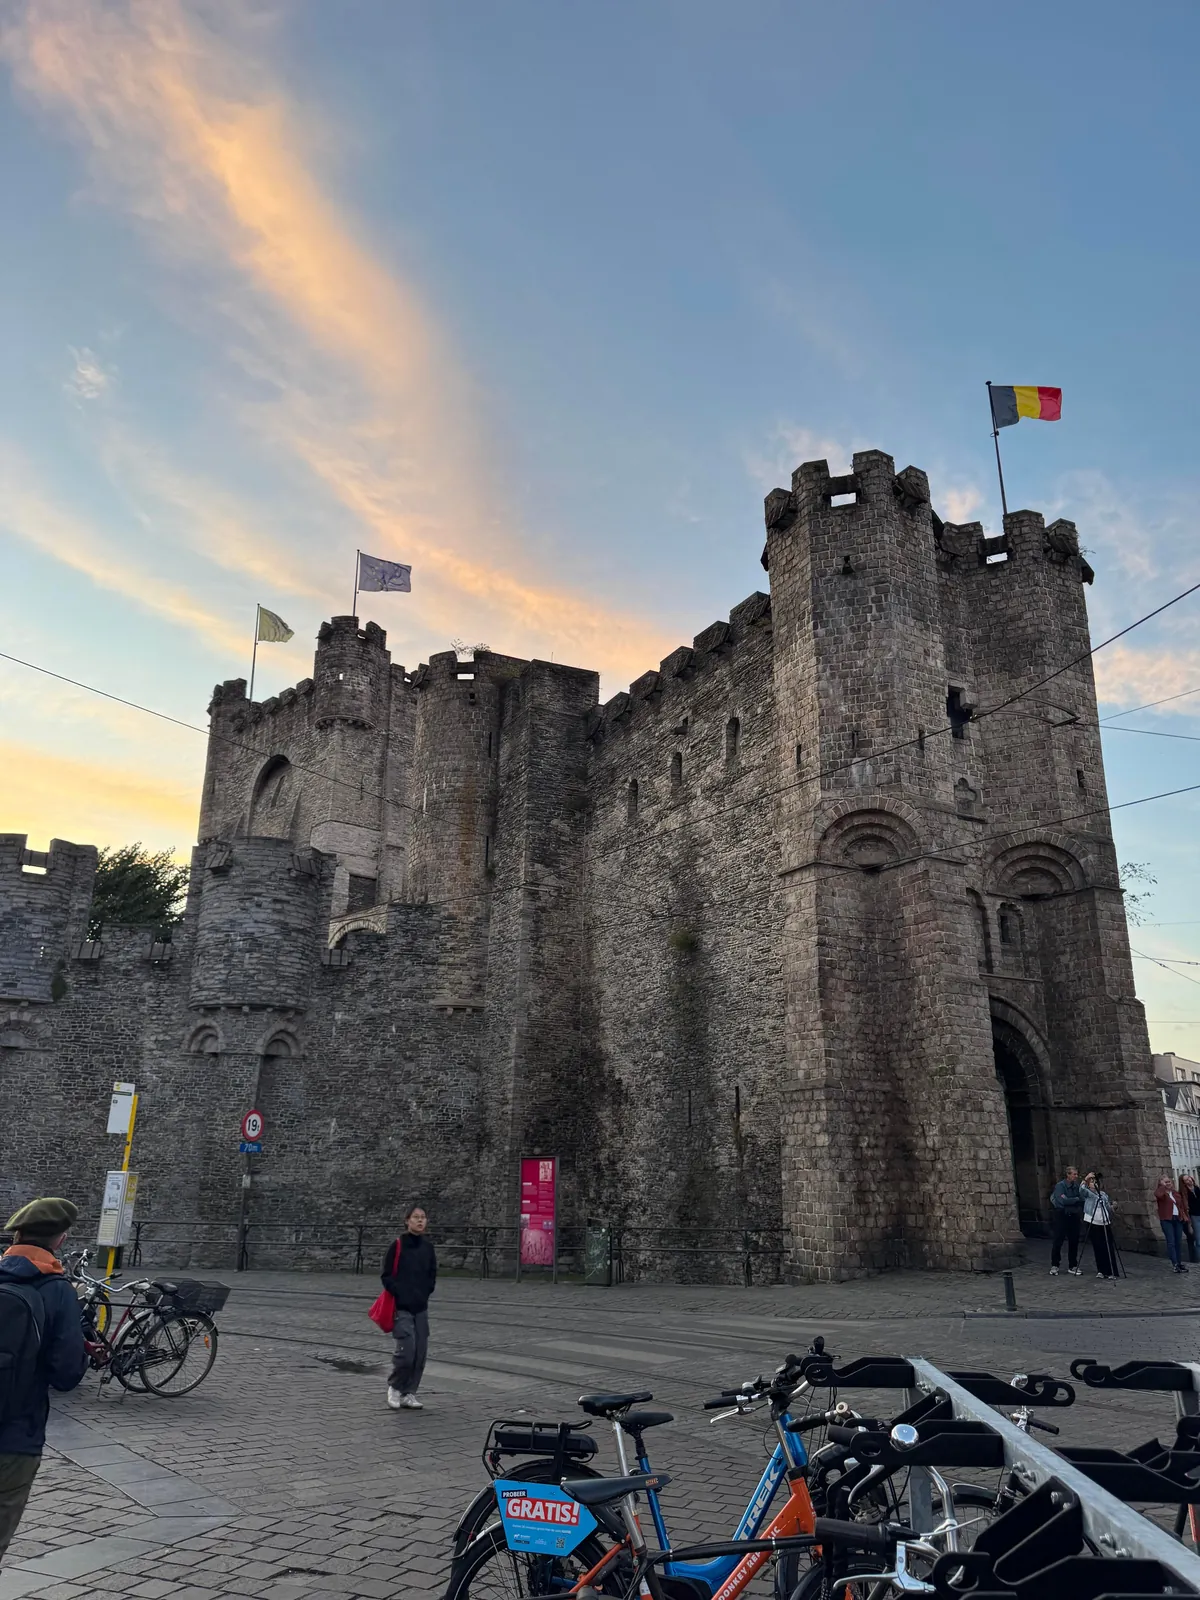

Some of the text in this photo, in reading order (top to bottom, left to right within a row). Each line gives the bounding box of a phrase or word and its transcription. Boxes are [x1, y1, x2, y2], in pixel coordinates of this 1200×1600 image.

[502, 1490, 526, 1498] PROBEER
[738, 1465, 780, 1540] TREK
[507, 1498, 580, 1524] GRATIS!
[718, 1566, 748, 1600] DONKEY
